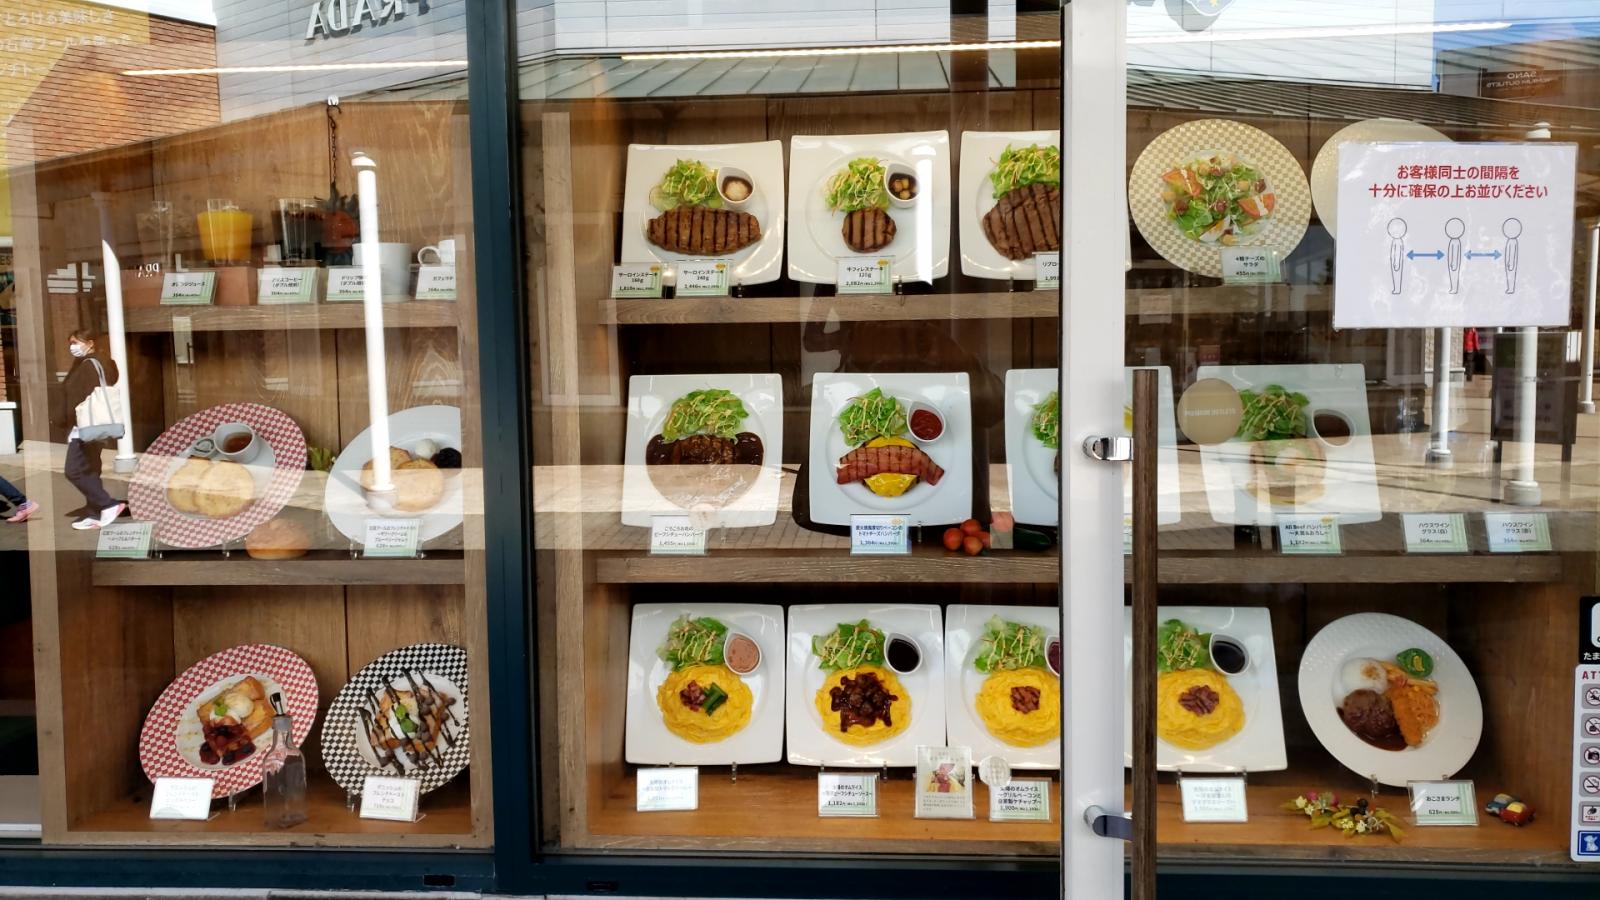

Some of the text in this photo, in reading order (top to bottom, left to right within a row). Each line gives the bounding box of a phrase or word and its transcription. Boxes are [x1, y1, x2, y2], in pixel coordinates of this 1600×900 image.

[1397, 165, 1520, 180] お客様同士の間隔を
[1368, 183, 1548, 199] 十分に確保の上お並びください
[1582, 670, 1600, 680] AT
